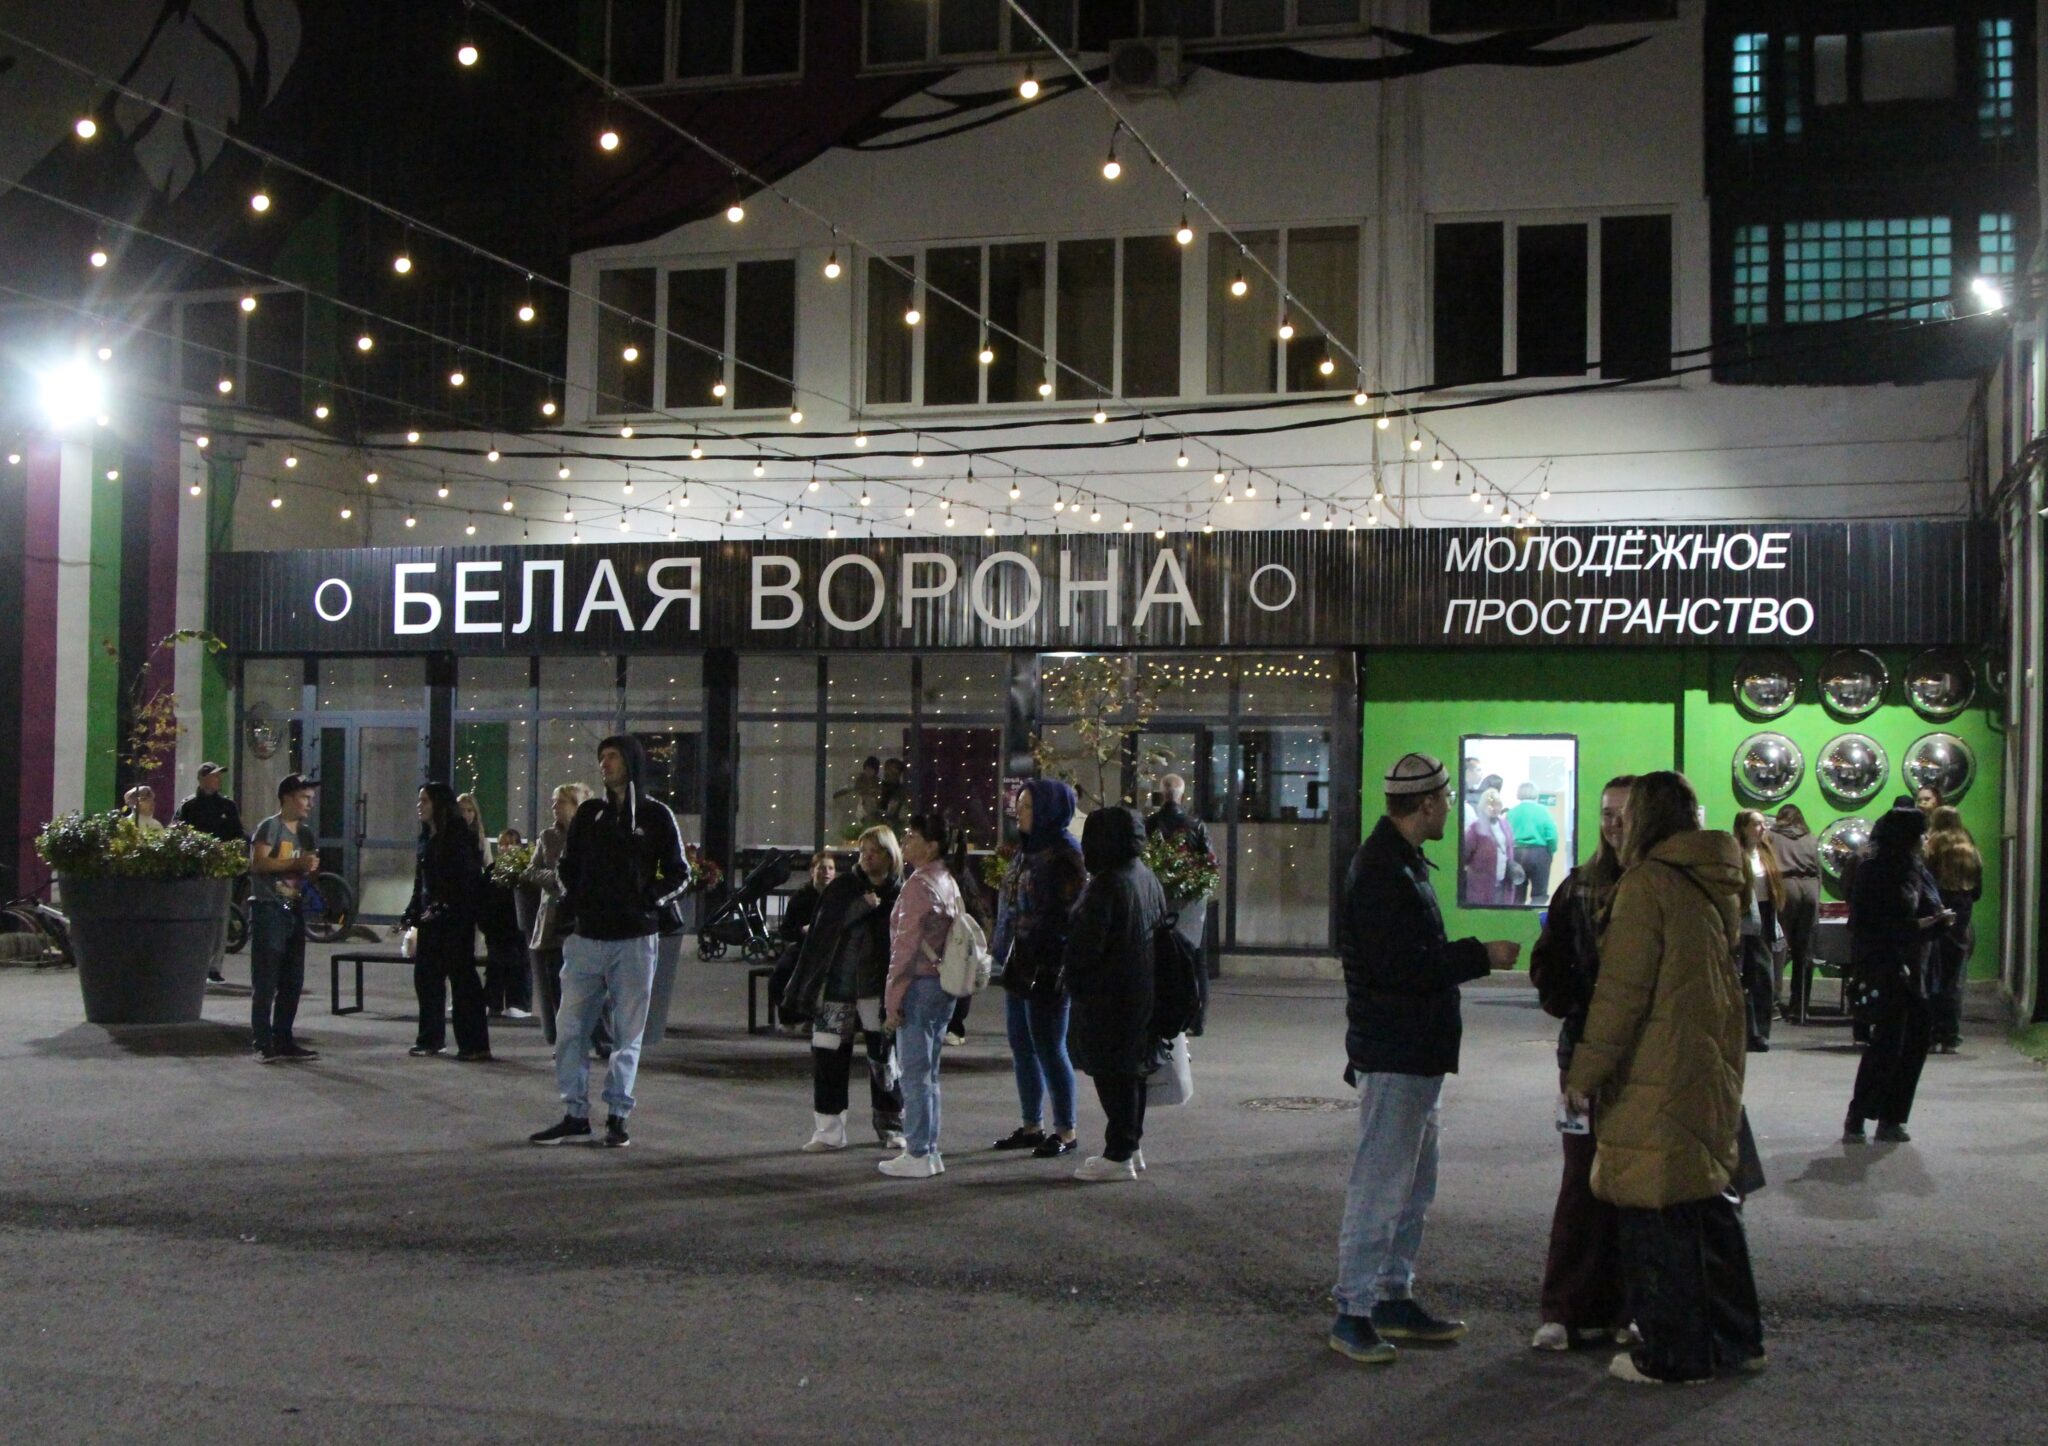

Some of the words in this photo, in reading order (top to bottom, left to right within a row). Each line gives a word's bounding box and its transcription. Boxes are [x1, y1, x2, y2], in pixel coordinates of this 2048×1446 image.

[1444, 529, 1792, 578] МОЛОДЁЖНОЕ
[393, 557, 700, 635] БЕЛАЯ
[750, 548, 1202, 633] ВОРОНА
[1442, 597, 1815, 637] ПРОСТРАНСТВО
